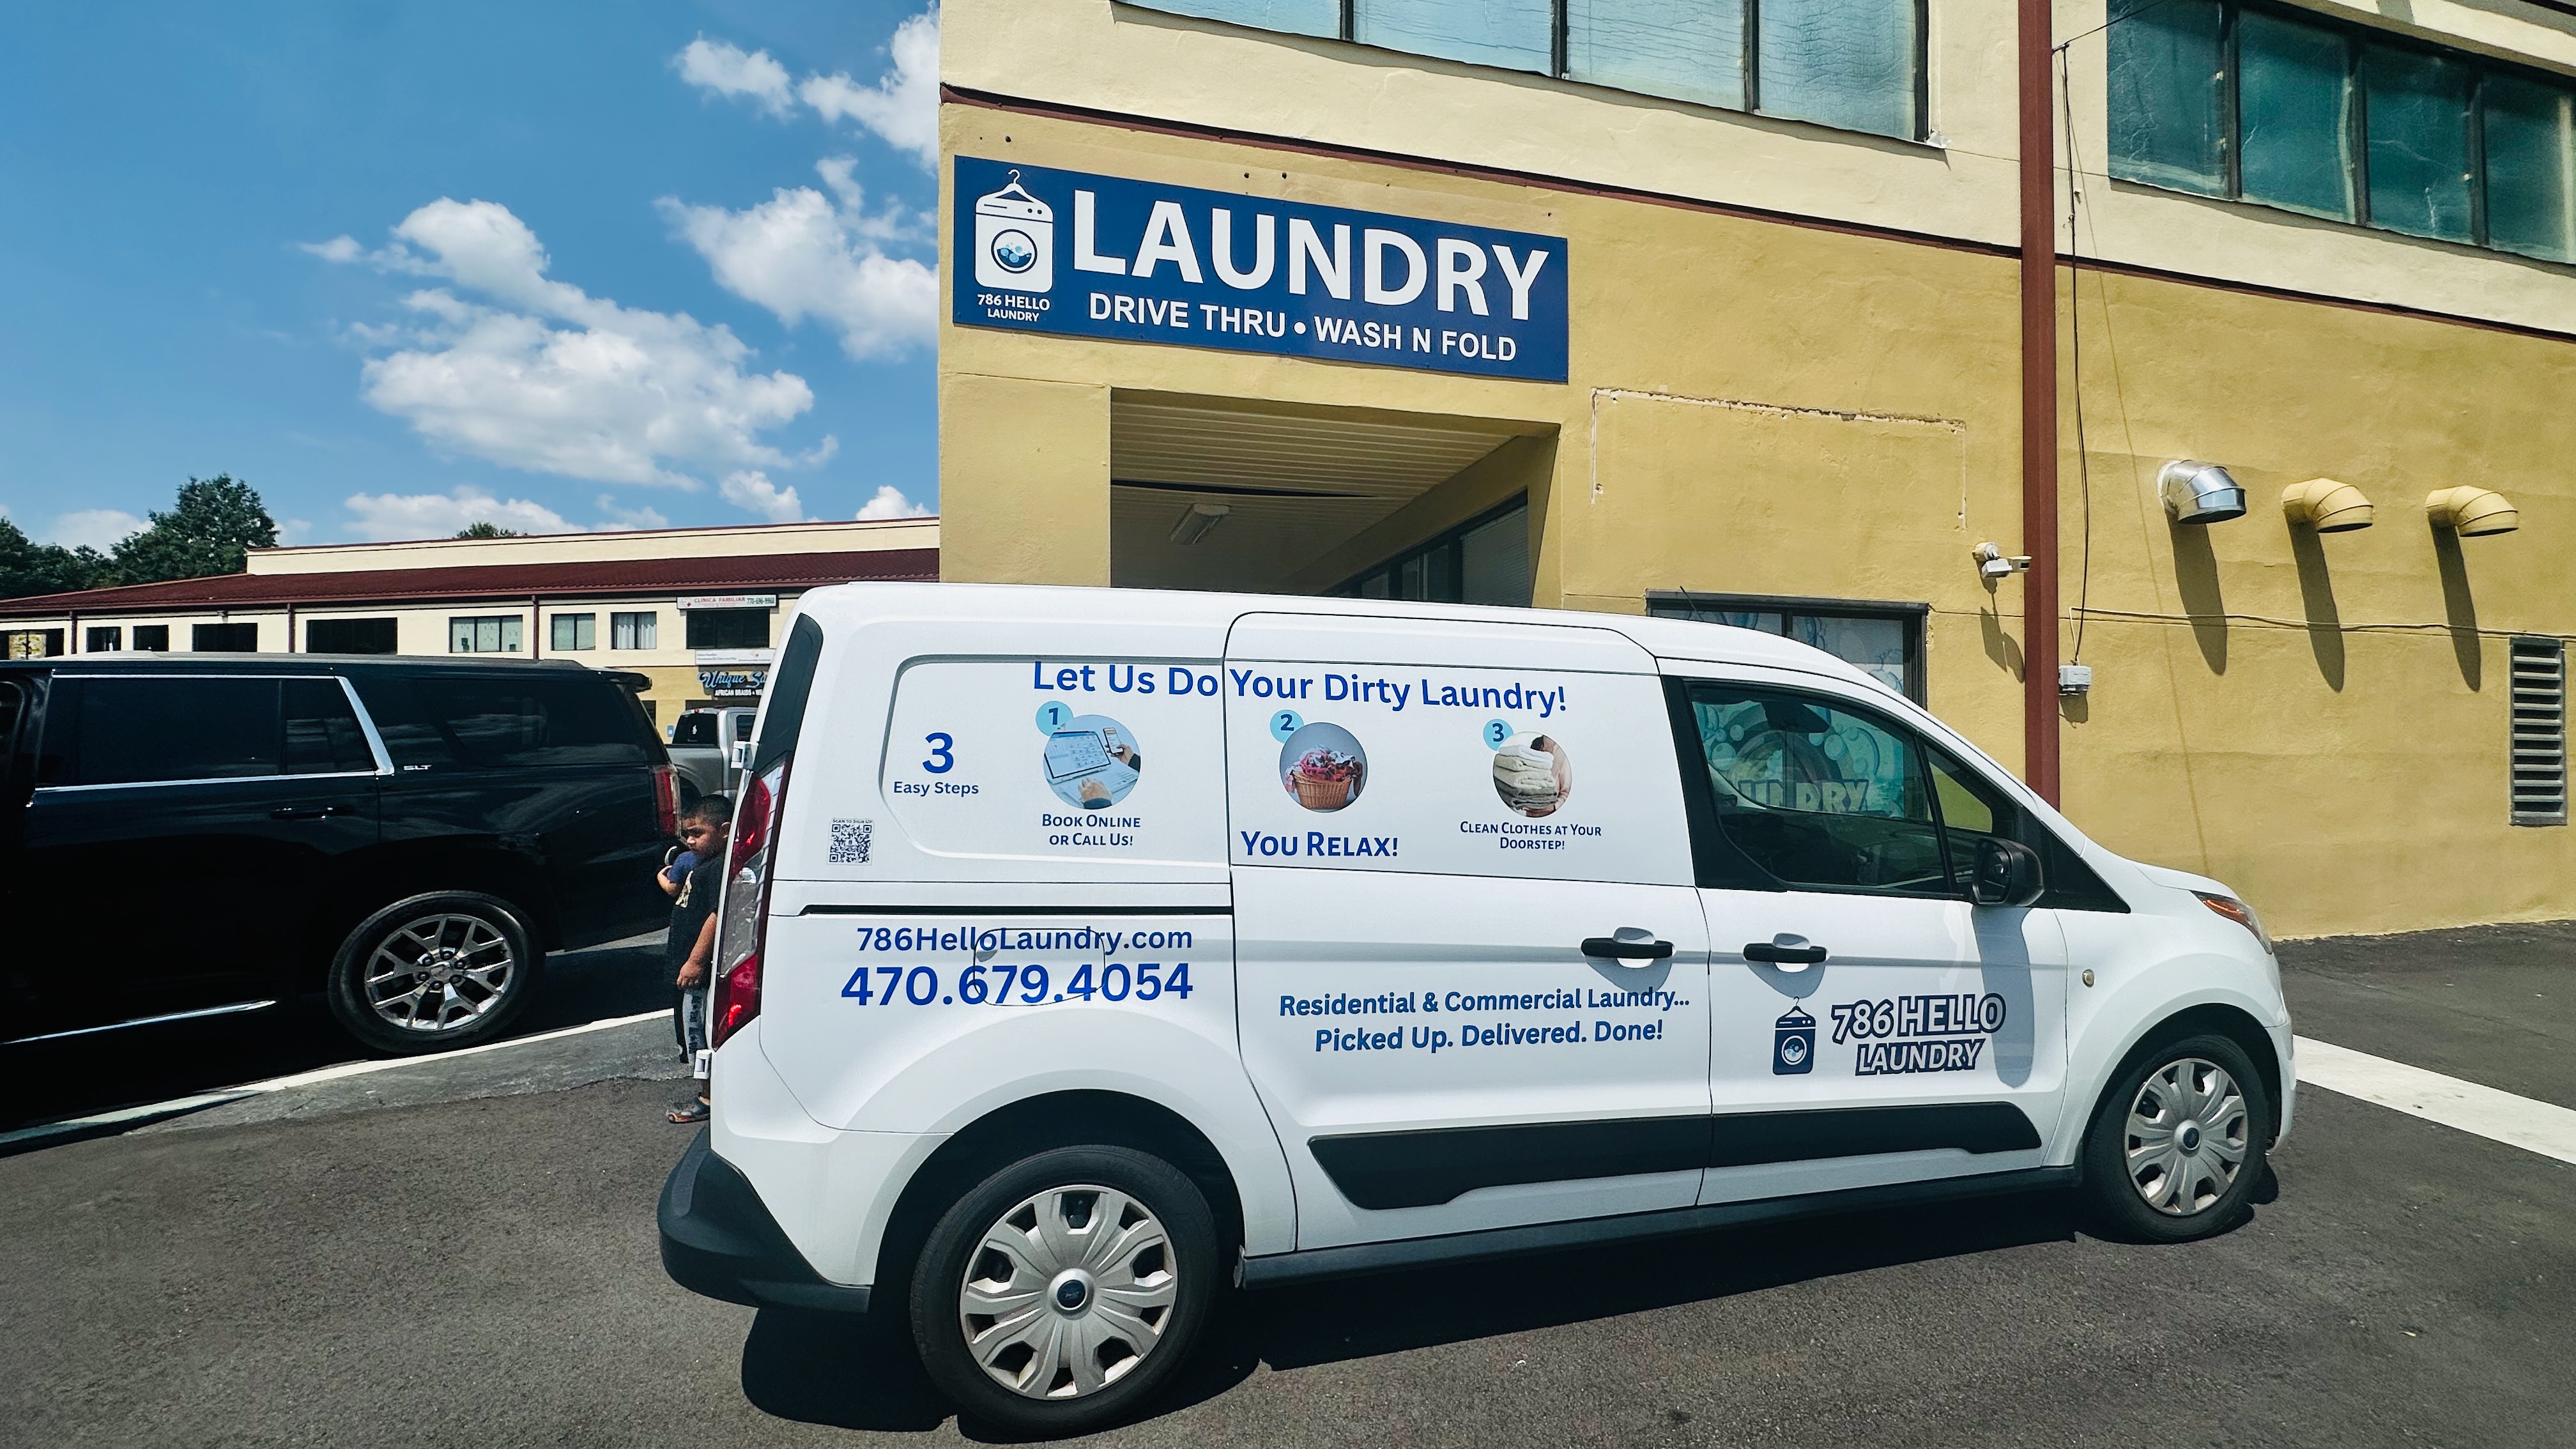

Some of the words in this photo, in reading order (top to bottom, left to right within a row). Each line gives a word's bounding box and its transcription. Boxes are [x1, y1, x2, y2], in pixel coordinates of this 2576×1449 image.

[1073, 190, 1549, 320] LAUNDRY
[977, 294, 1002, 306] 786
[1005, 295, 1050, 310] HELLO
[987, 308, 1039, 322] LAUNDRY
[1090, 292, 1189, 328] DRIVE
[1200, 304, 1285, 337] THRU
[1314, 316, 1401, 350] WASH
[1413, 327, 1430, 353] N
[1443, 330, 1516, 361] FOLD
[697, 671, 746, 688] Unique
[1034, 661, 1095, 692] Let
[1109, 665, 1155, 693] Us
[1169, 668, 1218, 696] Do
[1230, 670, 1314, 699] Your
[1324, 674, 1411, 711] Dirty
[1422, 679, 1566, 718] Laundry!
[1048, 707, 1059, 726] 1
[1280, 714, 1295, 732] 2
[1492, 723, 1505, 742] 3
[922, 732, 954, 774] 3
[893, 781, 930, 795] Easy
[934, 782, 979, 795] Steps
[1042, 813, 1083, 827] BOOK
[1086, 815, 1141, 828] ONLINE
[1460, 821, 1499, 833] CLEAN
[1501, 822, 1552, 835] CLOTHES
[1570, 824, 1602, 836] YOUR
[1073, 832, 1107, 845] CALL
[1241, 831, 1298, 856] YOU
[1307, 831, 1398, 857] RELAX!
[857, 926, 1192, 956] 786HelloLaundry.com
[841, 963, 1193, 1006] 470.679.4054
[1280, 992, 1416, 1016] Residential
[1422, 992, 1438, 1013] &
[1445, 988, 1581, 1012] Commercial
[1588, 987, 1690, 1011] Laundry...
[1831, 999, 1894, 1045] 786
[1897, 992, 2006, 1037] HELLO
[1315, 1026, 1403, 1052] Picked
[1412, 1026, 1453, 1054] Up.
[1462, 1022, 1586, 1046] Delivered.
[1594, 1019, 1662, 1042] Done!
[1855, 1038, 1986, 1077] LAUNDRY
